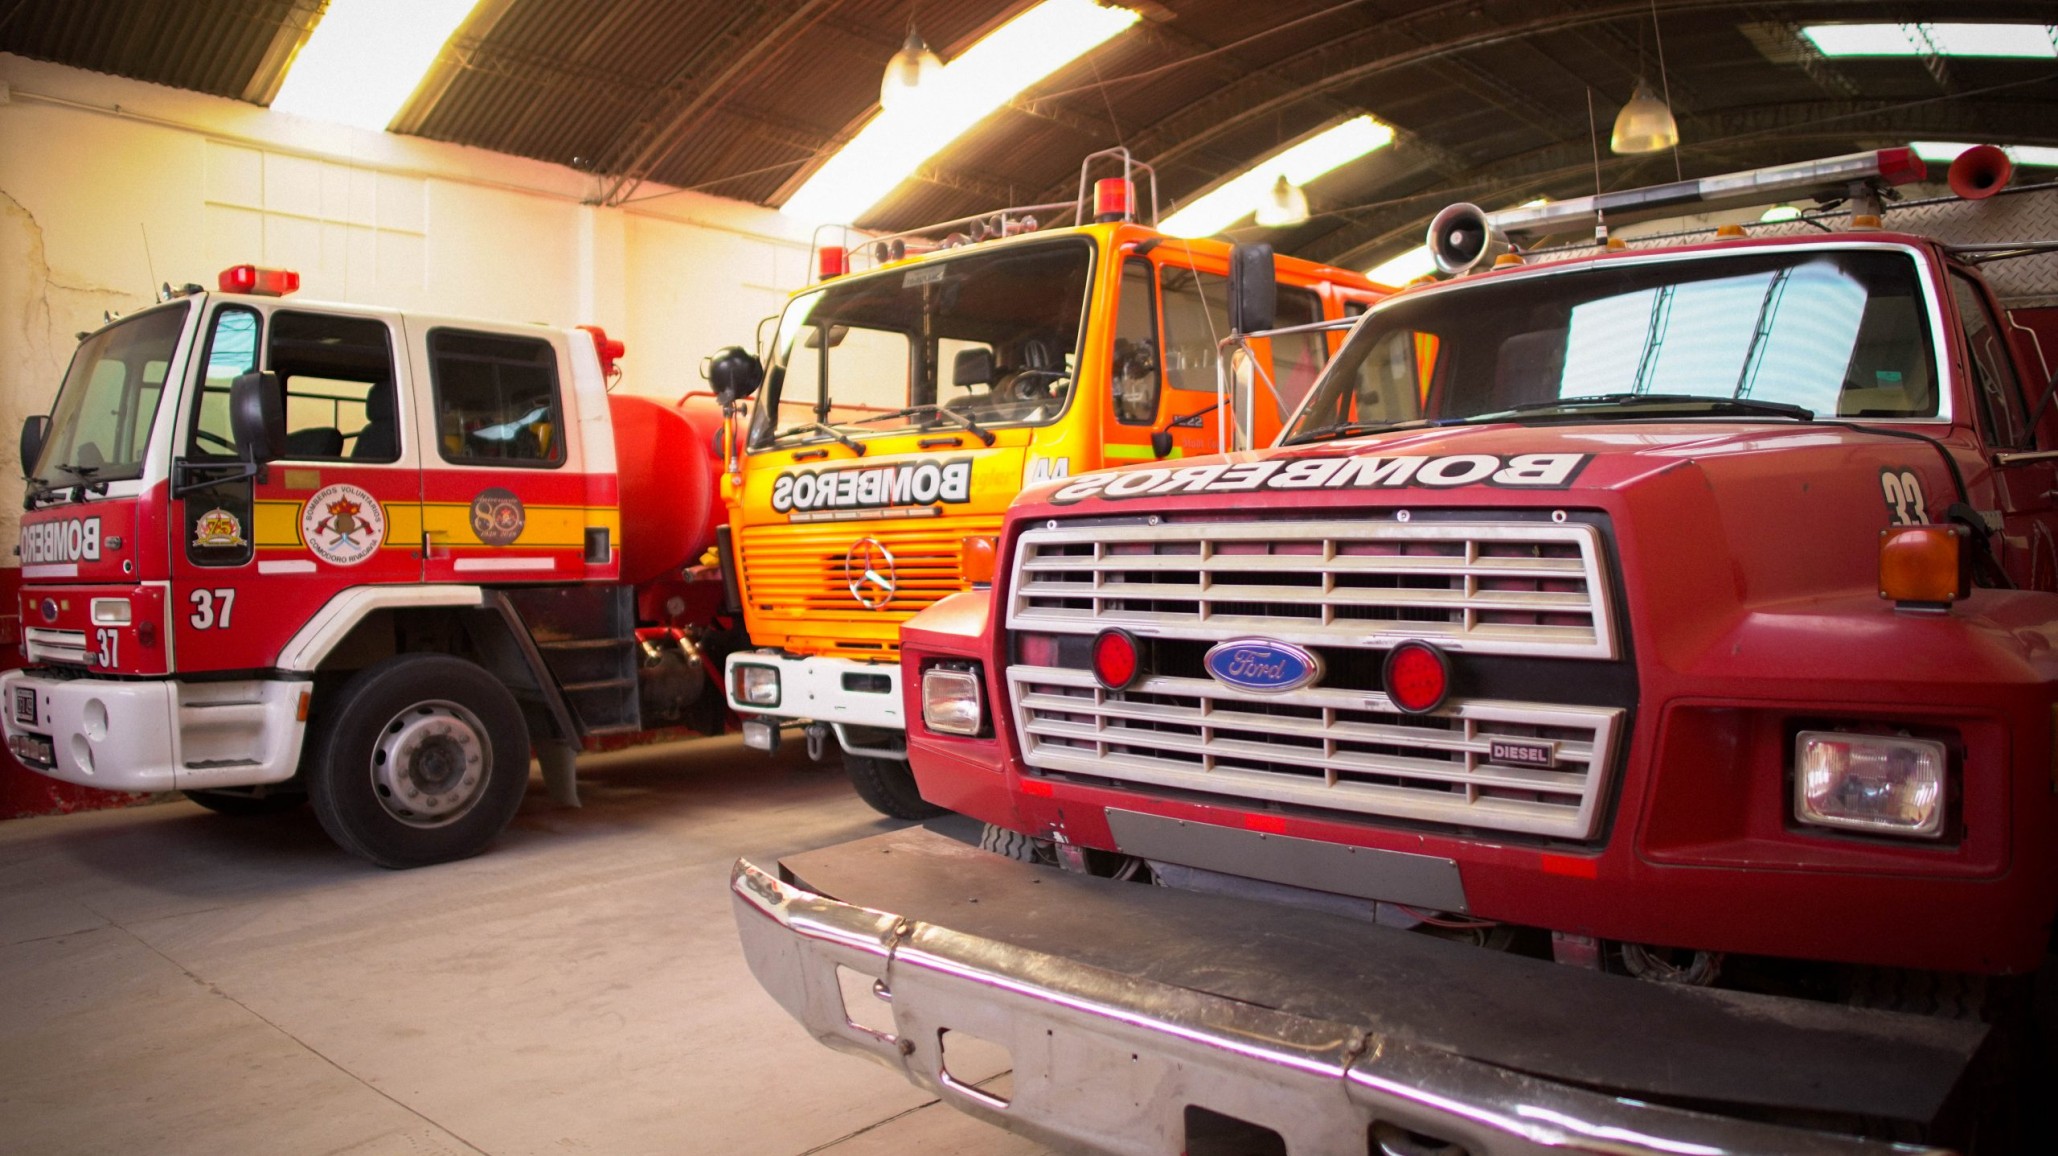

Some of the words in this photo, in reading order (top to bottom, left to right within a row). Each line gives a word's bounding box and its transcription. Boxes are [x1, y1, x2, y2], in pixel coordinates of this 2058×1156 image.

[306, 486, 338, 521] BOMBEROS
[341, 486, 382, 523] VOLUNTARIOS
[1882, 471, 1929, 526] 33
[206, 517, 231, 540] 75
[309, 538, 347, 563] COMODORO
[349, 539, 378, 562] RIVADAVIA
[190, 588, 235, 630] 37
[97, 628, 119, 668] 37
[1229, 649, 1286, 679] Ford
[1494, 745, 1547, 761] DIESEL
